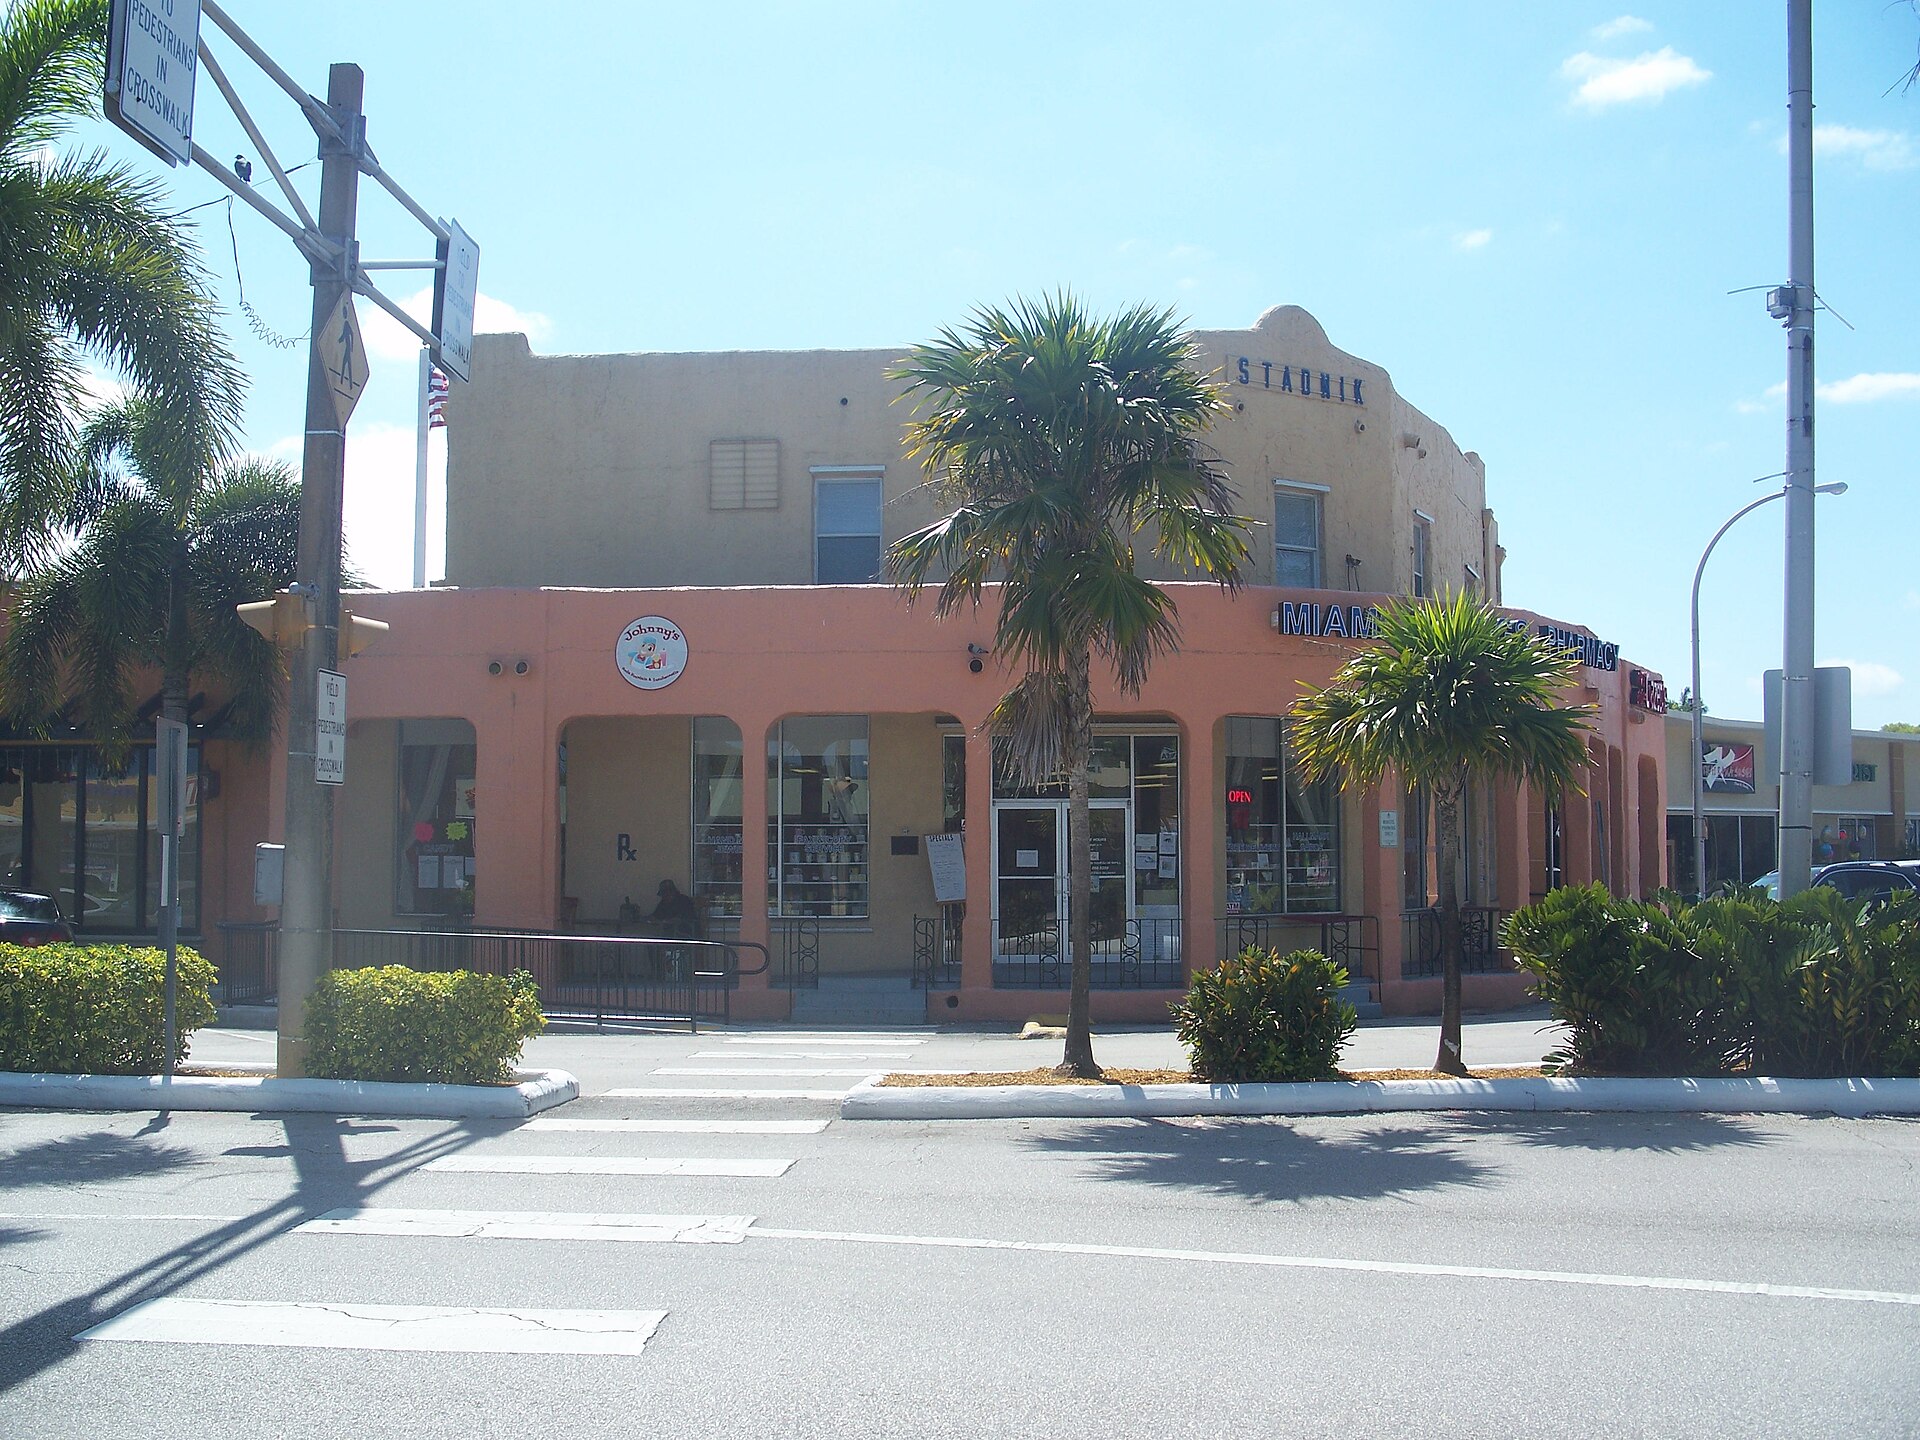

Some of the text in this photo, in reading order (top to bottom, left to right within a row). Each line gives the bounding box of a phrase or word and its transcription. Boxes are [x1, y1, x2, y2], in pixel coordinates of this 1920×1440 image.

[131, 2, 194, 72] PEDESTRIANS
[156, 55, 168, 84] IN
[127, 67, 189, 136] CROSSWALK
[1238, 356, 1364, 405] STADNIK
[1279, 601, 1382, 638] MIAM
[624, 624, 680, 641] Johnny's
[1542, 625, 1619, 671] PHARMACY
[327, 682, 339, 697] YIELD
[329, 702, 335, 716] TO
[318, 719, 345, 736] PEDESTRIANS
[318, 758, 343, 773] CROSSWALK
[1229, 791, 1251, 803] OPEN
[929, 833, 954, 842] SPECIALS
